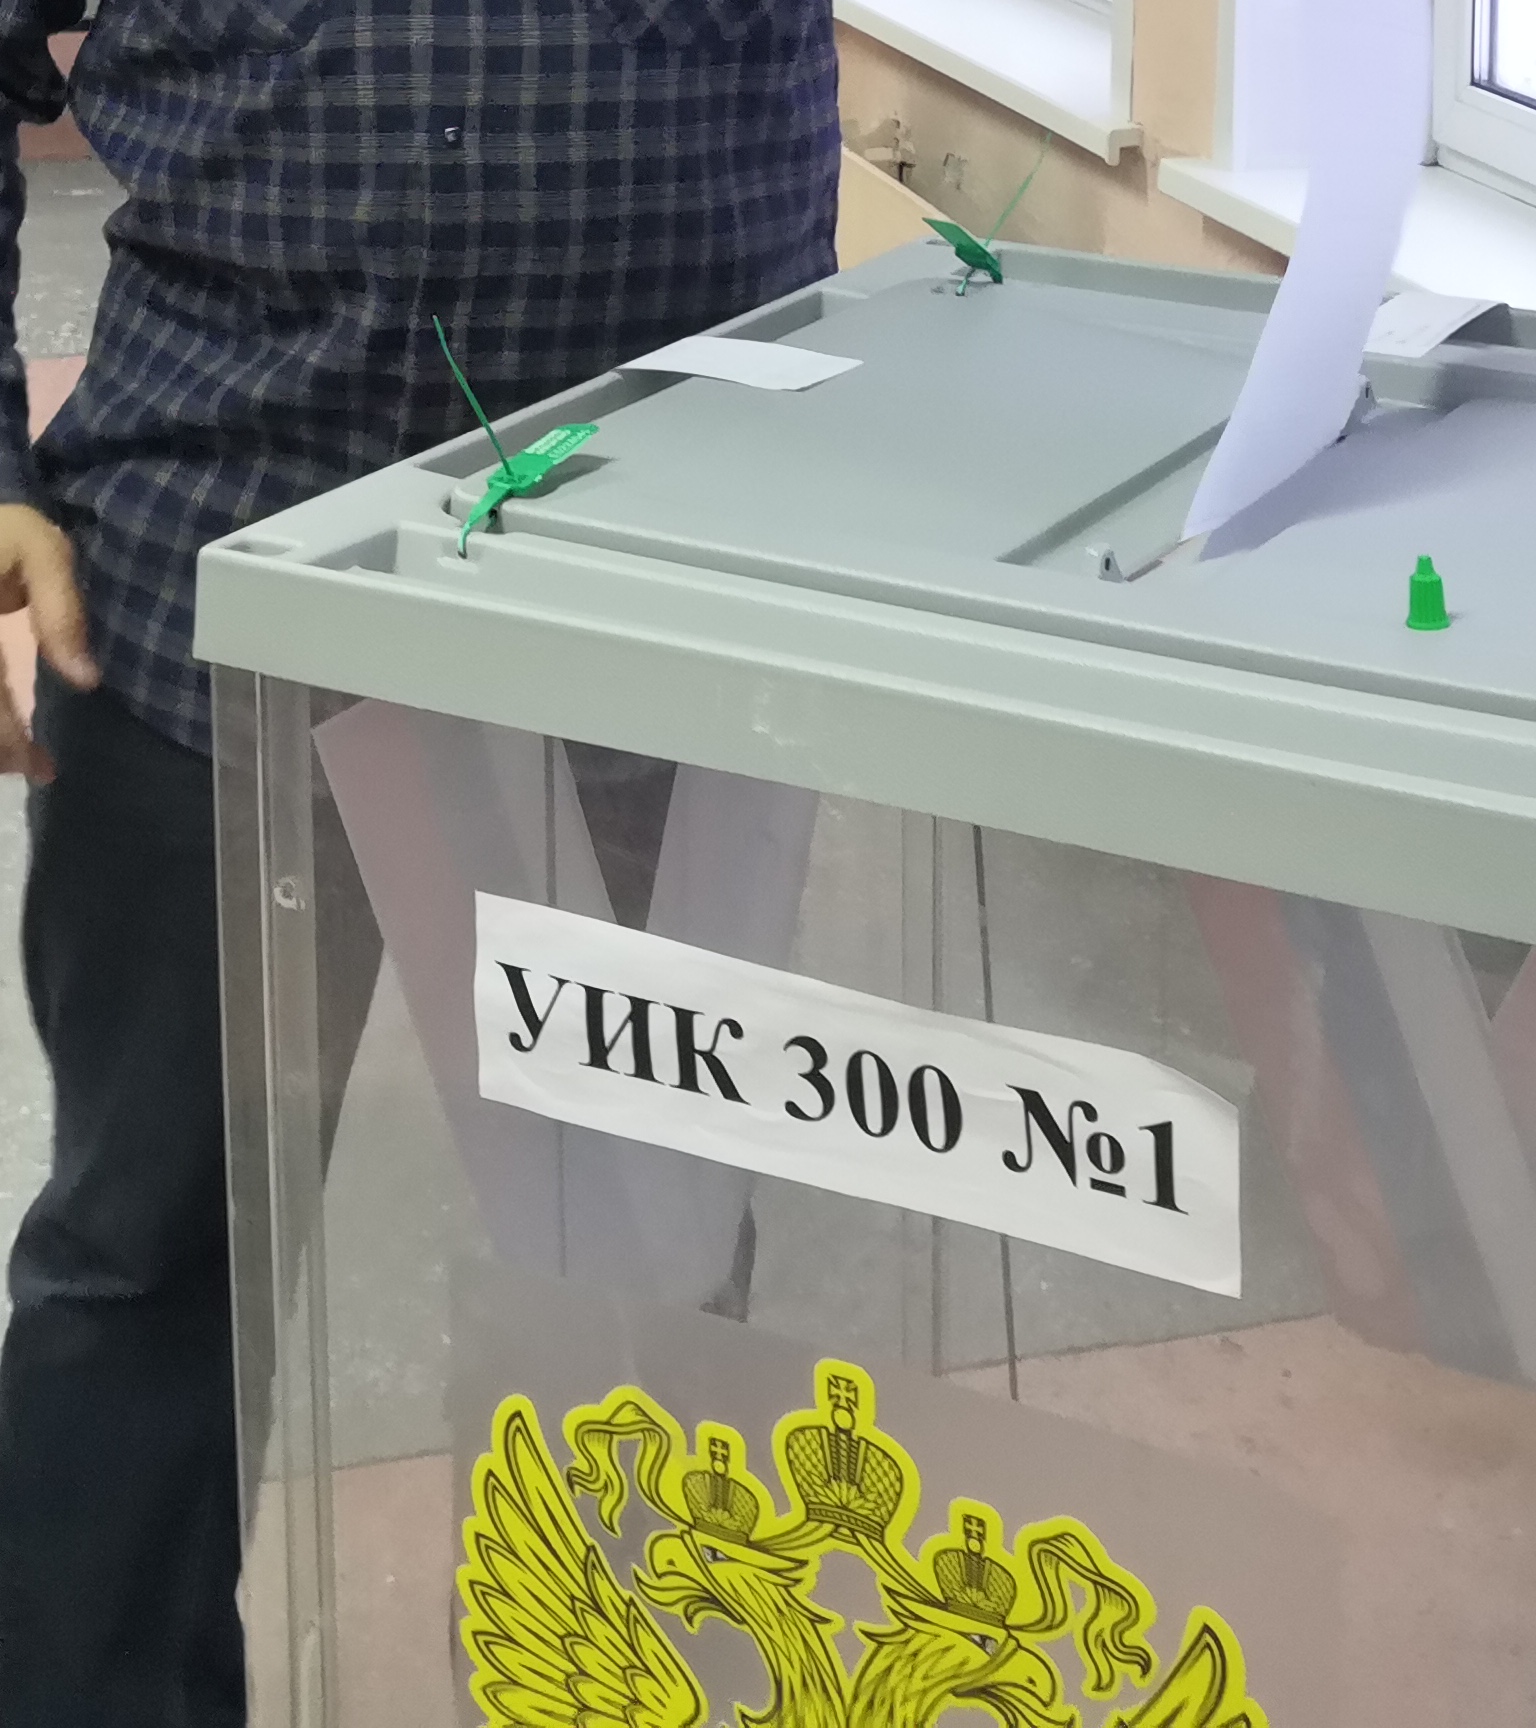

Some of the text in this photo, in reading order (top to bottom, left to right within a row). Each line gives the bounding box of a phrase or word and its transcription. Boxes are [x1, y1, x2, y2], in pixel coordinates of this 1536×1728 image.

[495, 960, 1190, 1215] УИК 300 №1
